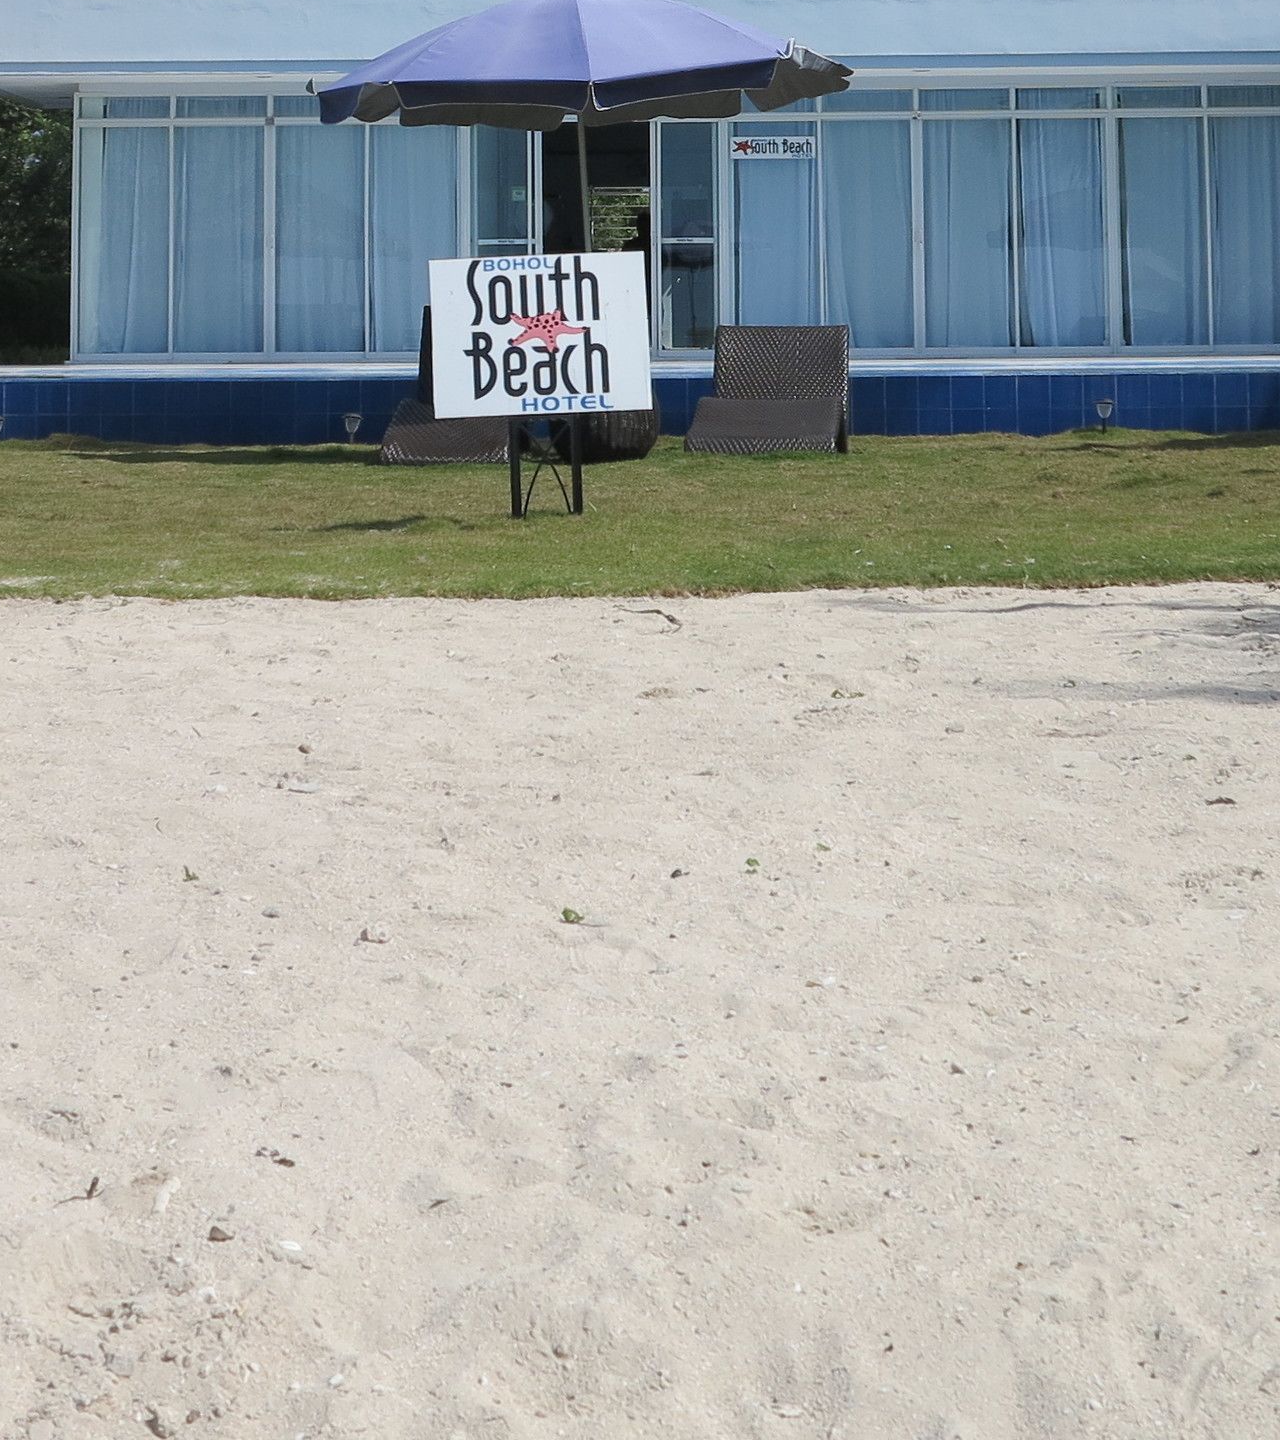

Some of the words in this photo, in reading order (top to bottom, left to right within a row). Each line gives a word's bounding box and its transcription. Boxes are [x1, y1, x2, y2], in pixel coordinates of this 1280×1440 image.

[751, 139, 779, 154] South
[782, 138, 812, 154] Beach
[482, 257, 554, 272] BOHOL
[466, 255, 601, 326] South
[463, 327, 610, 400] Beach
[521, 395, 614, 411] HOTEL
